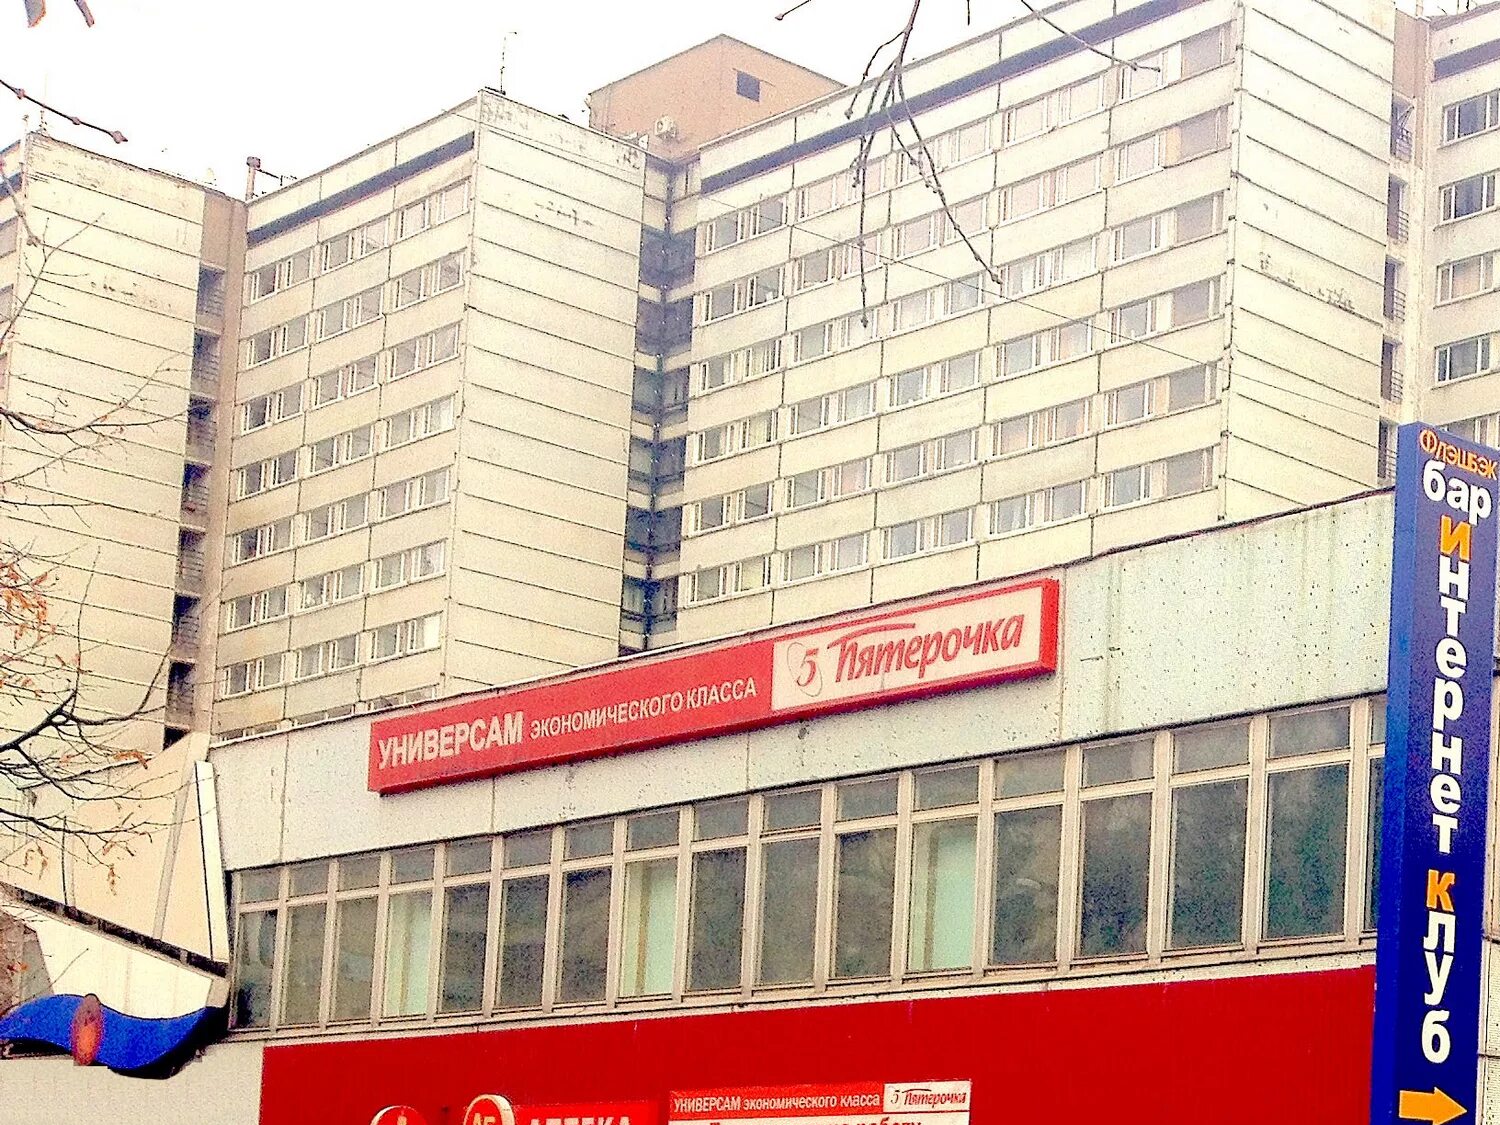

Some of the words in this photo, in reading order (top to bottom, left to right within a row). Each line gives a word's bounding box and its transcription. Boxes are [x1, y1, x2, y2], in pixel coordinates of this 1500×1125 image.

[1422, 459, 1492, 526] бар
[796, 648, 819, 688] 5
[827, 614, 1025, 684] Пятерочка
[377, 711, 525, 770] УНИВЕРСАМ
[529, 691, 683, 740] ЭКОНОМИЧЕСКОГО
[686, 676, 757, 707] КЛАССА
[674, 1096, 741, 1113] УНИВЕРСАМ
[743, 1095, 837, 1112] экономического
[840, 1093, 881, 1108] класса
[902, 1088, 967, 1109] Пятерочка
